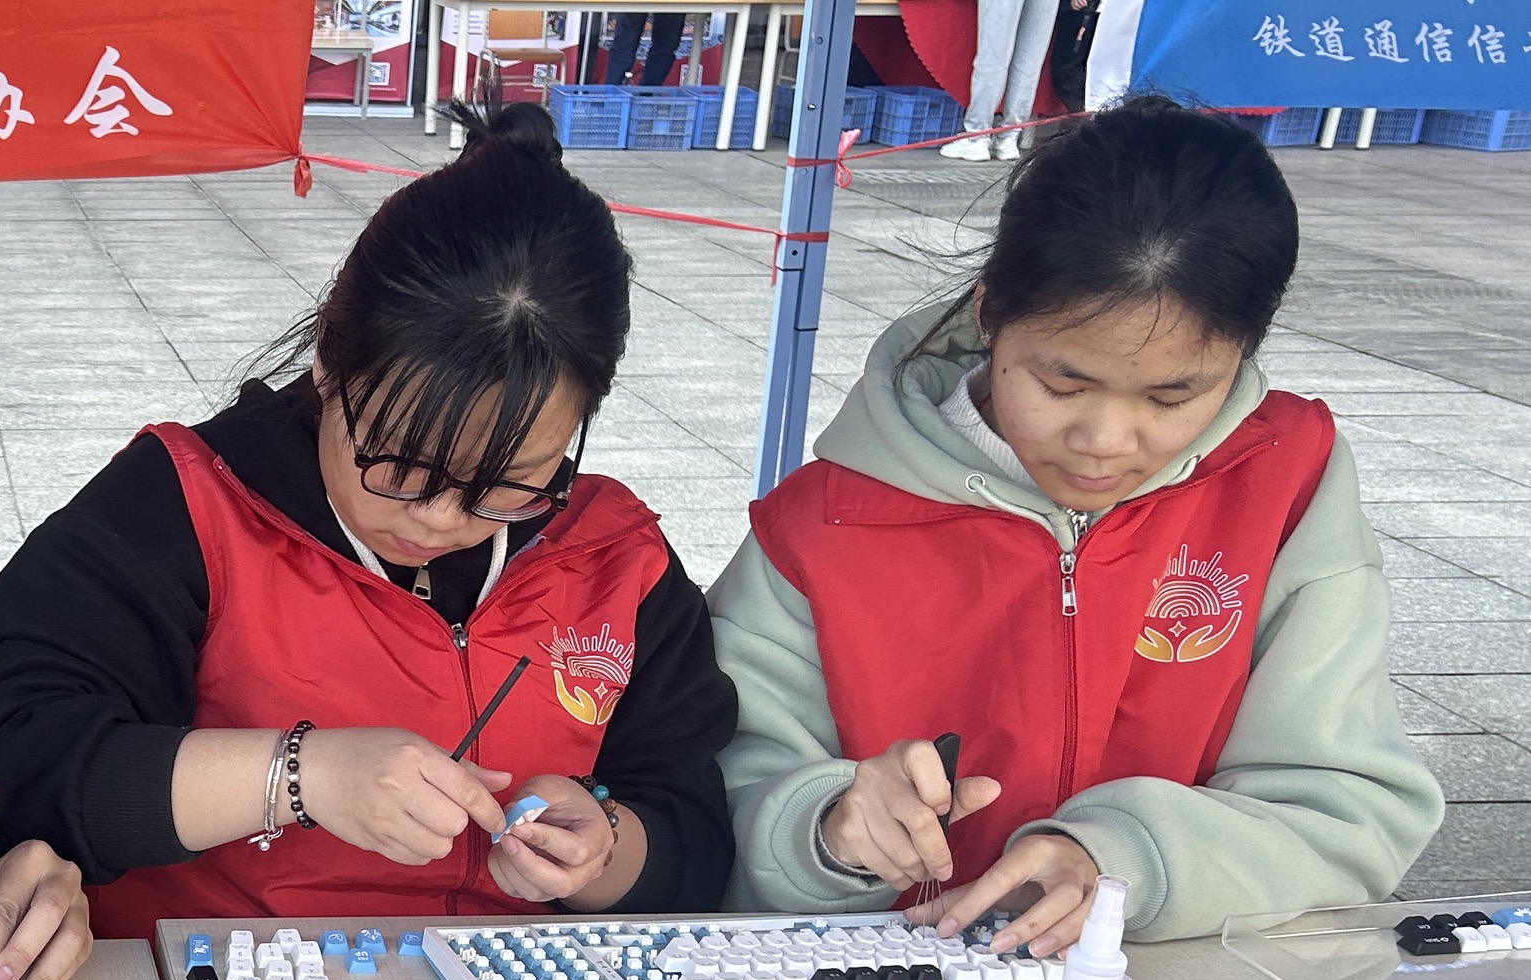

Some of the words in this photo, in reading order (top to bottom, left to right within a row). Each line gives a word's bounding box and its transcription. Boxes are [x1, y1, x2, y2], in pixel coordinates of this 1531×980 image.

[1252, 14, 1531, 63] 铁道通信信
